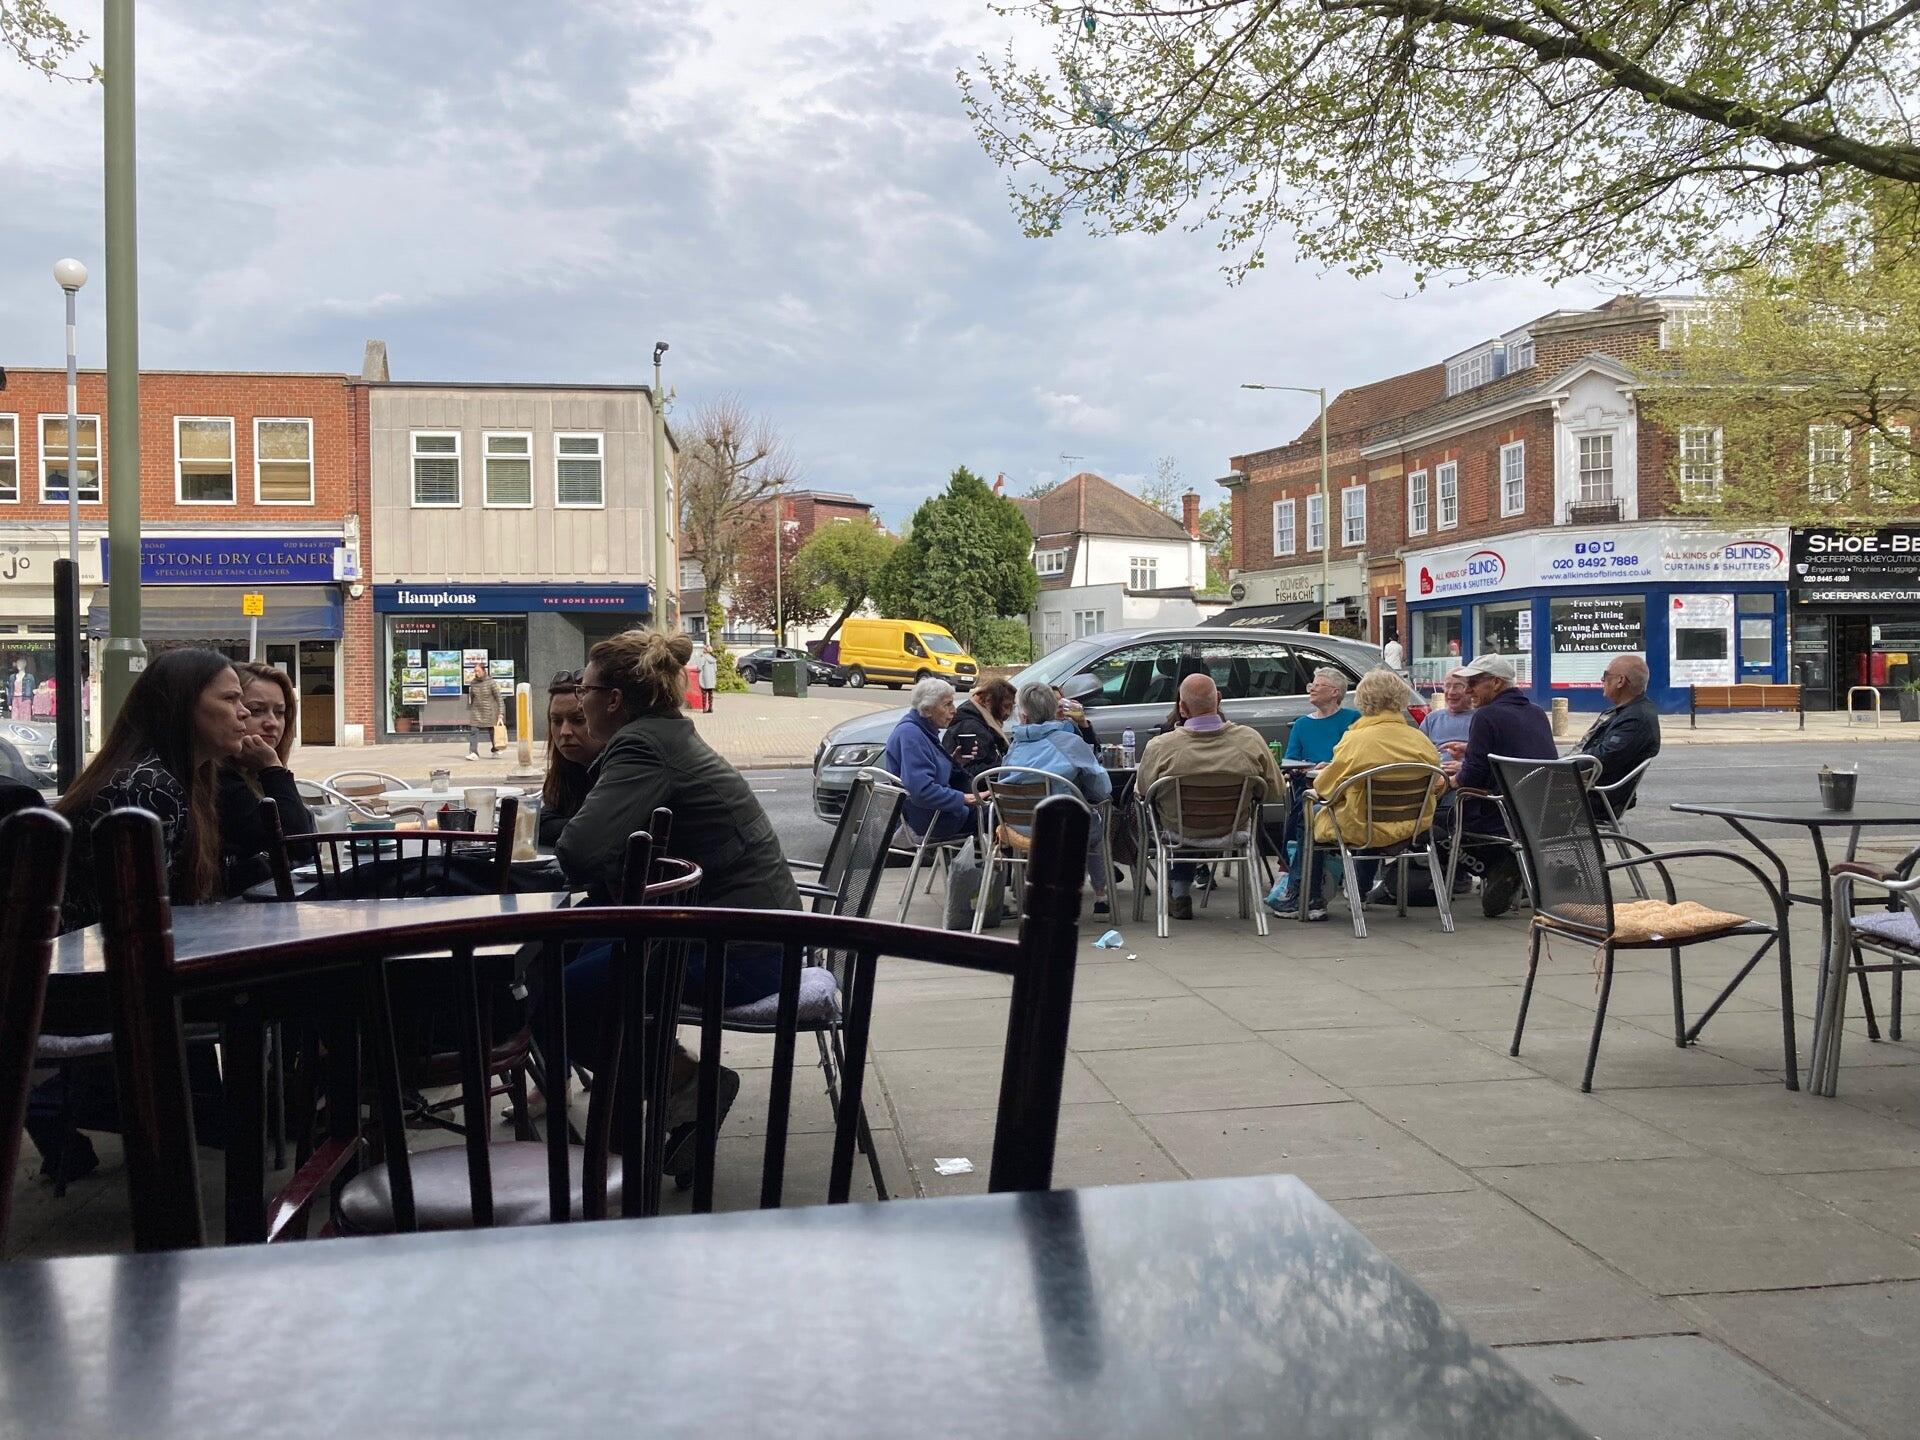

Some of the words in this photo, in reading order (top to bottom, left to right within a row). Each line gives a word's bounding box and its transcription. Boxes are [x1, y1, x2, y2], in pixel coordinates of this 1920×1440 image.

[1808, 534, 1920, 552] SHOE-BE
[139, 553, 213, 565] ETSTONE
[219, 552, 251, 564] DRY
[1710, 552, 1720, 560] OF
[1725, 548, 1771, 560] BLINDS
[1553, 559, 1574, 570] 020
[1578, 557, 1606, 568] 8492
[1610, 556, 1638, 566] 7888
[155, 568, 202, 577] SPECIALIST
[1445, 570, 1460, 579] KINDS
[1469, 559, 1498, 576] BLINDS
[1540, 568, 1652, 580] www.allkindsofblinds.co.uk
[1812, 566, 1846, 574] Engraving
[1851, 566, 1880, 574] Trophies
[1887, 566, 1918, 574] Luggage
[1436, 582, 1462, 593] CURTAINS
[1468, 578, 1498, 588] SHUTTERS
[398, 590, 476, 607] Hamptons
[1812, 592, 1836, 600] SHOE
[1837, 592, 1870, 600] REPAIRS
[1879, 592, 1896, 600] KEY
[1594, 599, 1624, 608] Survey
[1594, 611, 1624, 620] Fitting
[1558, 624, 1590, 632] Evening
[1602, 622, 1640, 630] Weekend
[1570, 631, 1628, 640] Appointments
[1600, 642, 1638, 650] Covered
